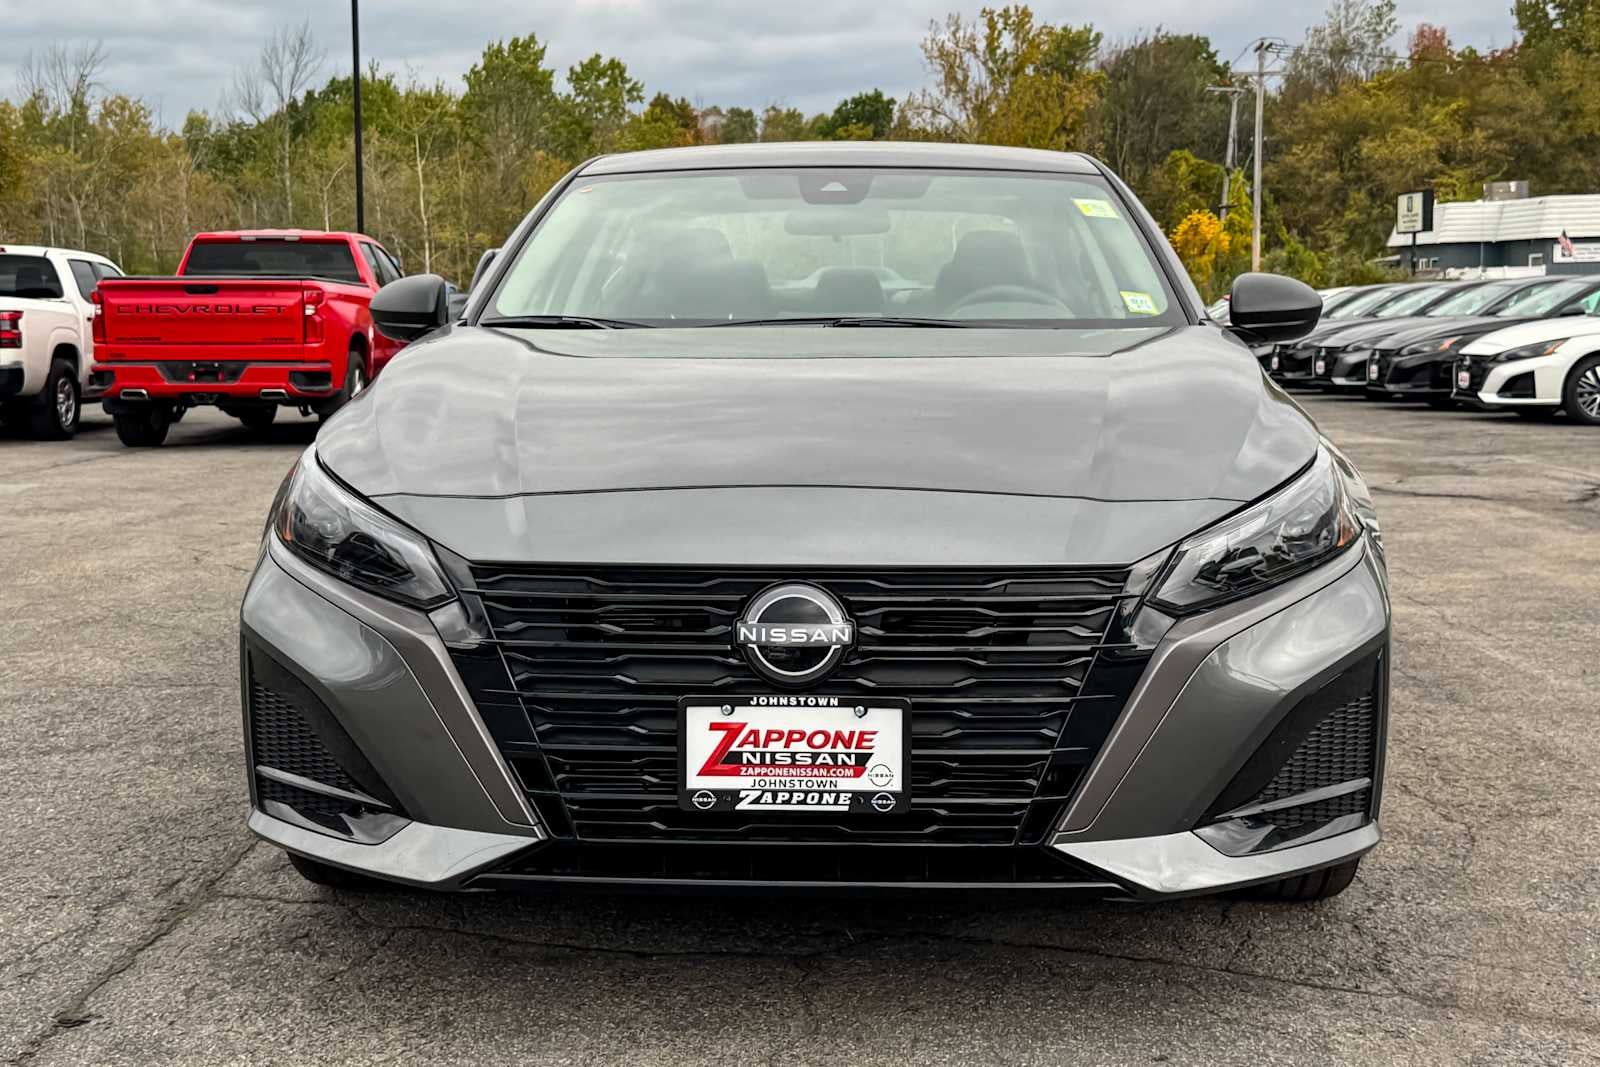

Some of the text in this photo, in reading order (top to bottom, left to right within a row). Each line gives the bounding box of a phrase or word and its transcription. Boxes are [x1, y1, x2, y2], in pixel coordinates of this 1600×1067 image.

[117, 304, 286, 316] CHEVROLET
[740, 627, 849, 643] NISSAN
[750, 697, 839, 706] JOHNSTOWN
[696, 722, 879, 777] ZAPPONE
[742, 753, 856, 765] NISSAN
[740, 767, 854, 777] ZAPPONENISSAN.COM
[750, 779, 838, 788] JOHNSTOWN
[735, 790, 852, 811] ZAPPONE
